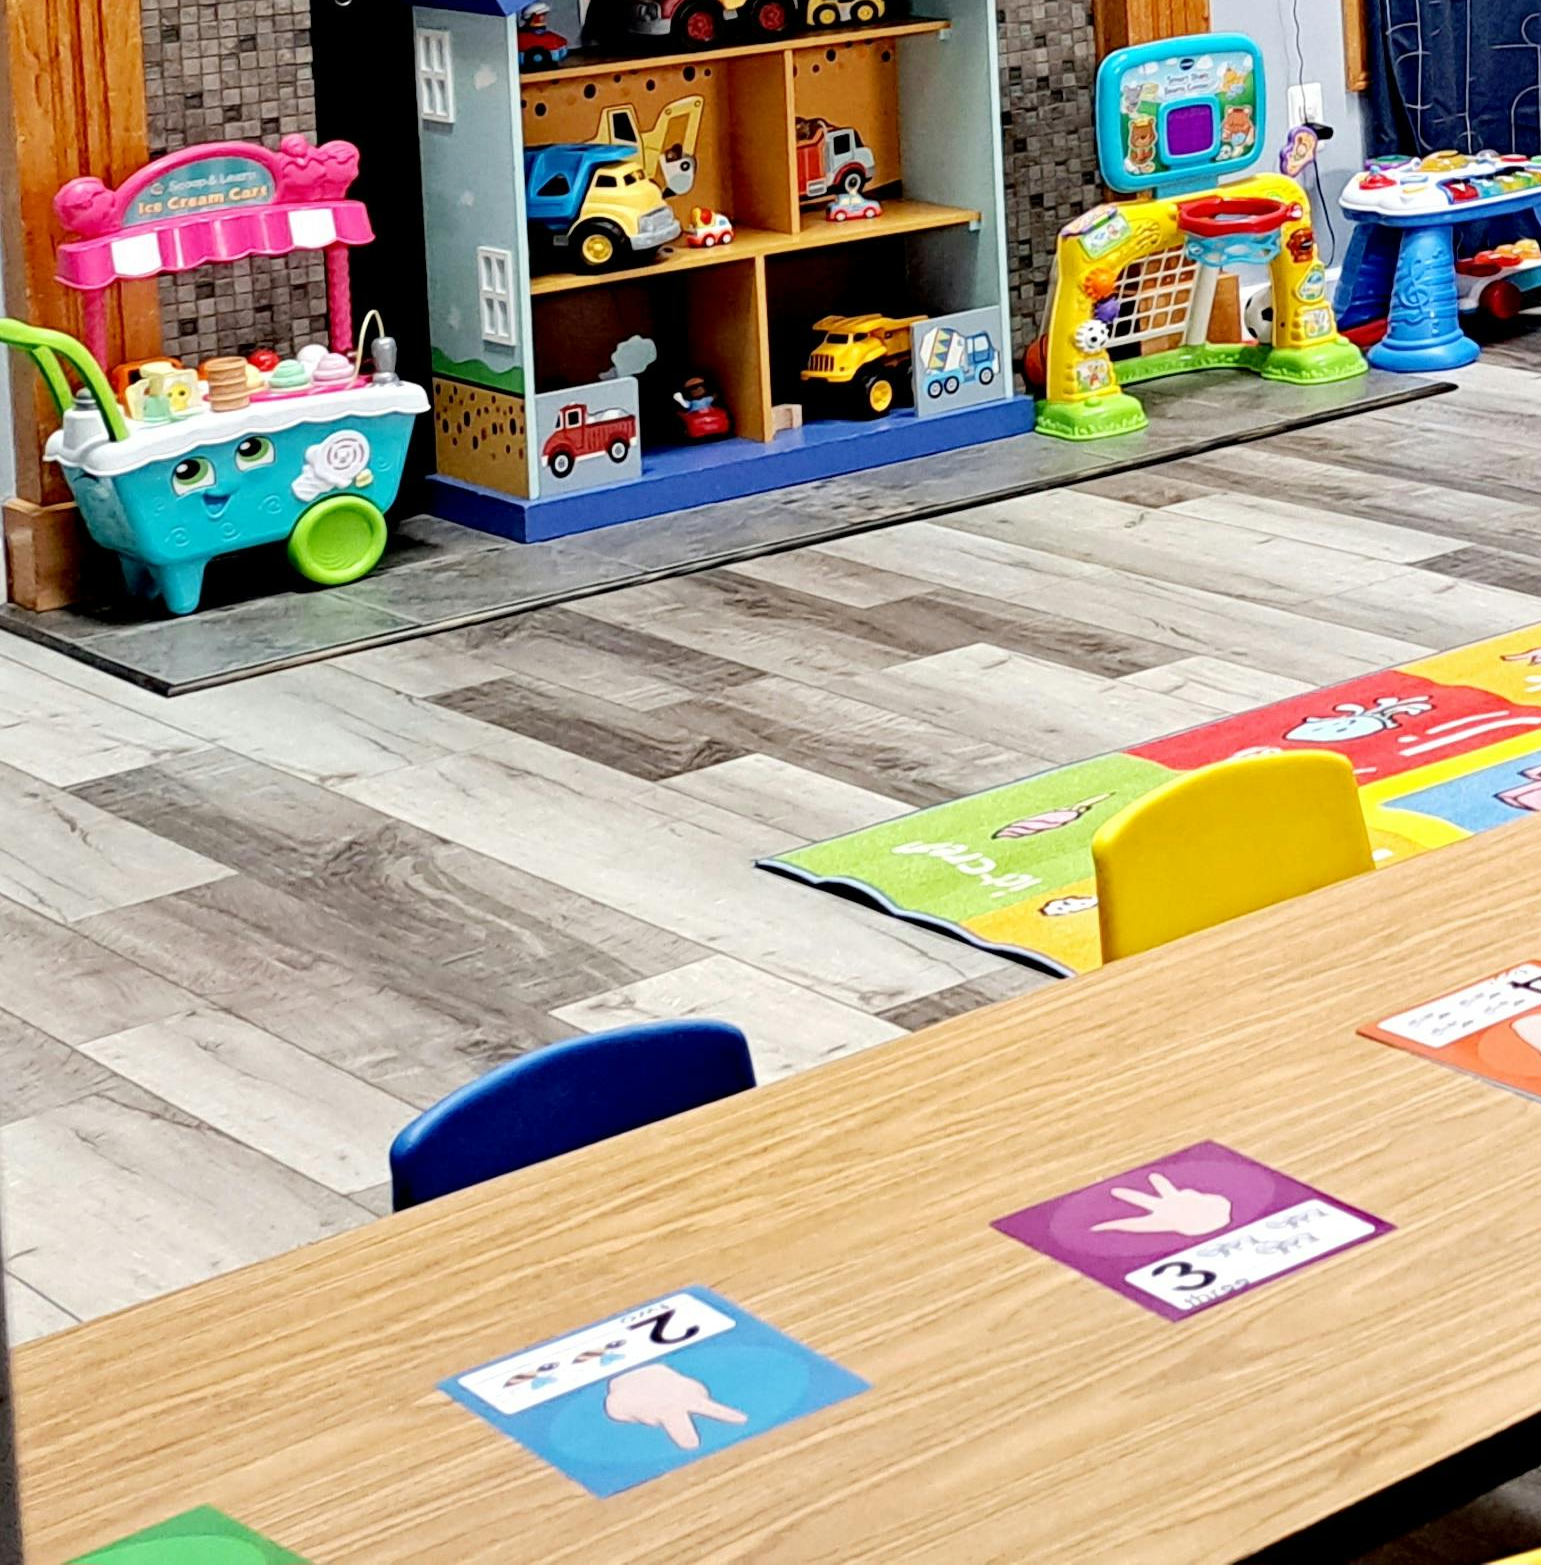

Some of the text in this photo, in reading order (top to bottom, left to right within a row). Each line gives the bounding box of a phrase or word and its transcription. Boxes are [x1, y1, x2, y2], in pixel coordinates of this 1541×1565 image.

[138, 185, 268, 215] Ice Cream Cart
[1150, 1261, 1218, 1292] 3
[626, 1308, 700, 1345] 2
